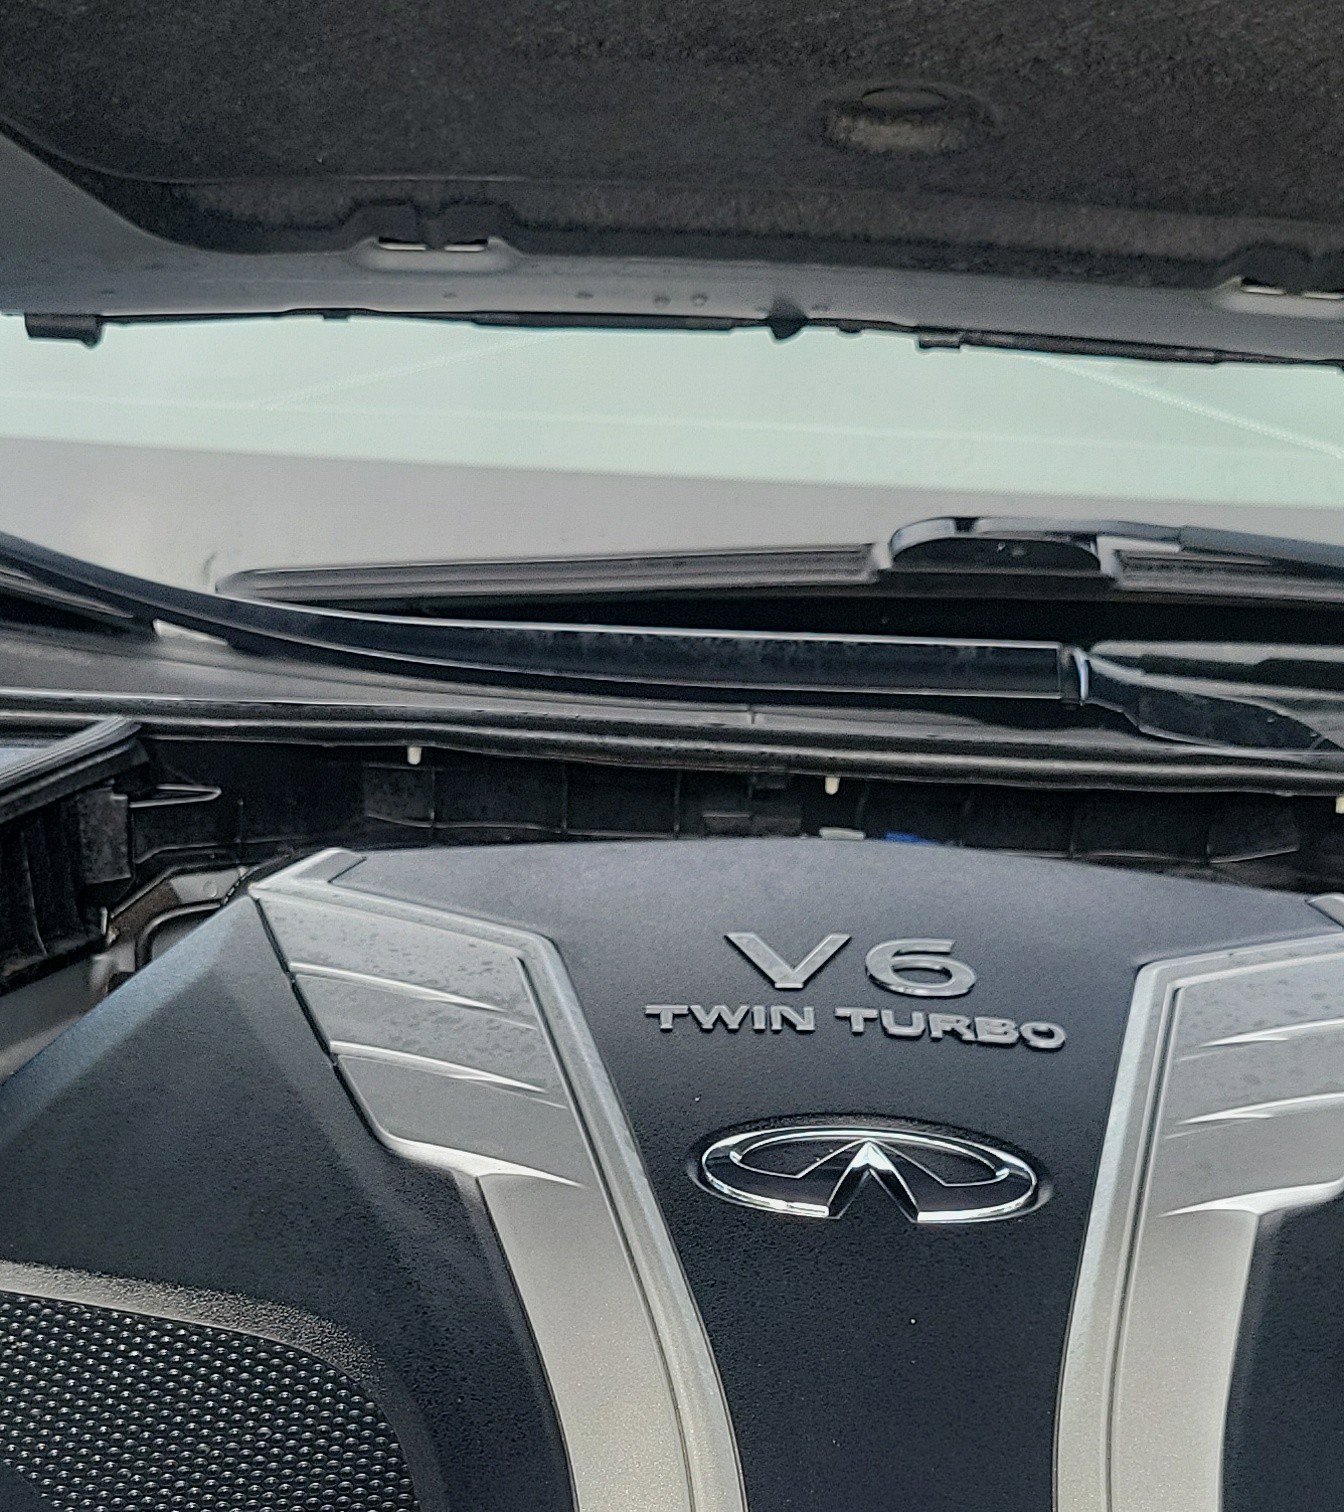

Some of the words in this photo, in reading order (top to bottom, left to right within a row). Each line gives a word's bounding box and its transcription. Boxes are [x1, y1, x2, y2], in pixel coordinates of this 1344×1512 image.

[724, 932, 976, 997] V6
[645, 1004, 816, 1032] TWIN
[834, 1006, 1067, 1050] TURBO
